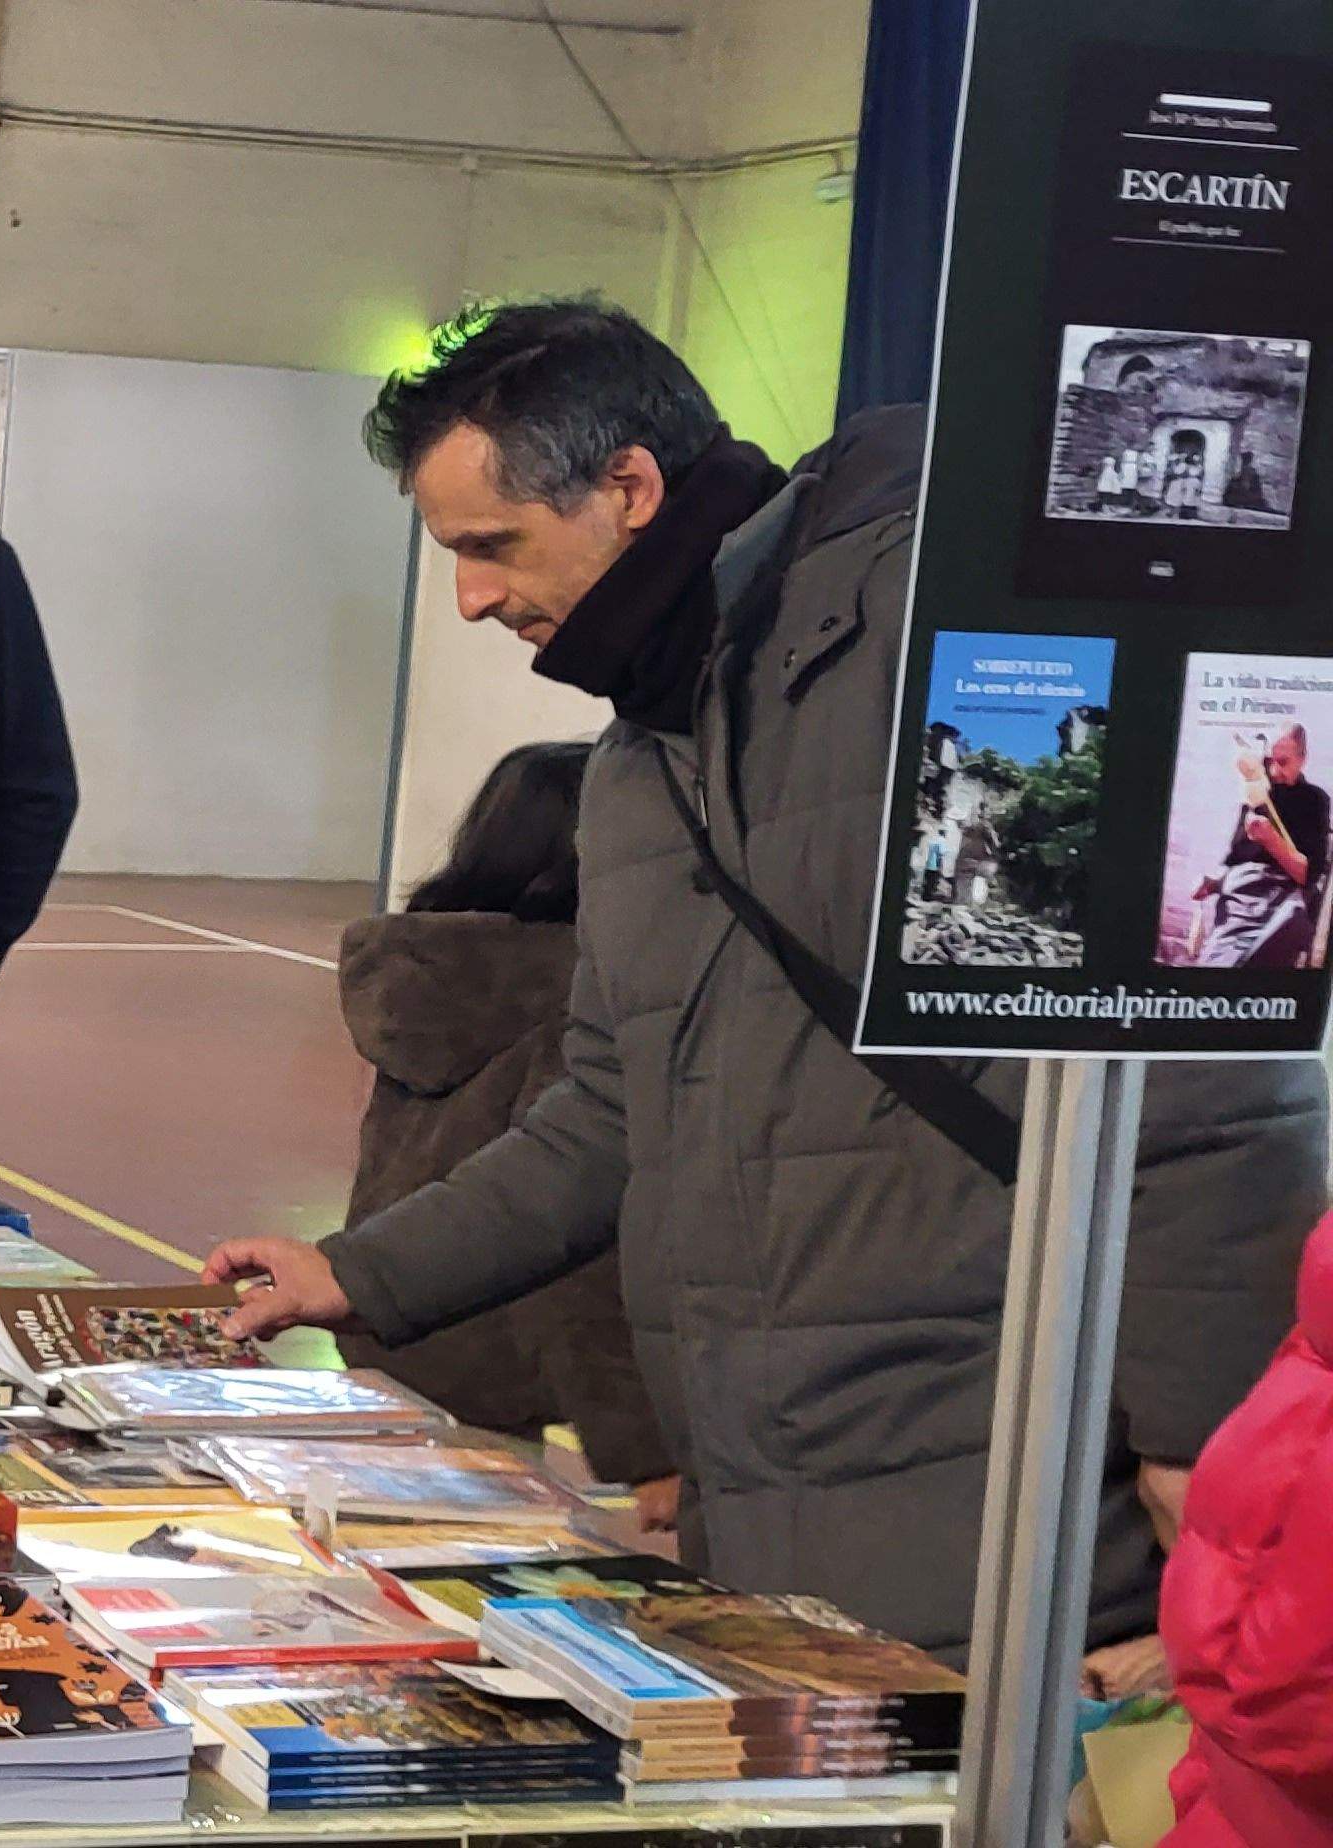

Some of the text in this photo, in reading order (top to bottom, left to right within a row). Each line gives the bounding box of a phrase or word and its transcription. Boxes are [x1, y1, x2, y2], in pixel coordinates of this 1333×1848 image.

[1119, 167, 1293, 211] ESCARTÍN
[955, 678, 981, 696] Los
[1014, 680, 1035, 697] del
[1038, 681, 1087, 698] silencio
[1202, 670, 1262, 690] La vida
[1200, 697, 1297, 715] en el Pirineo
[906, 984, 1298, 1029] www.editorialpirineo.com
